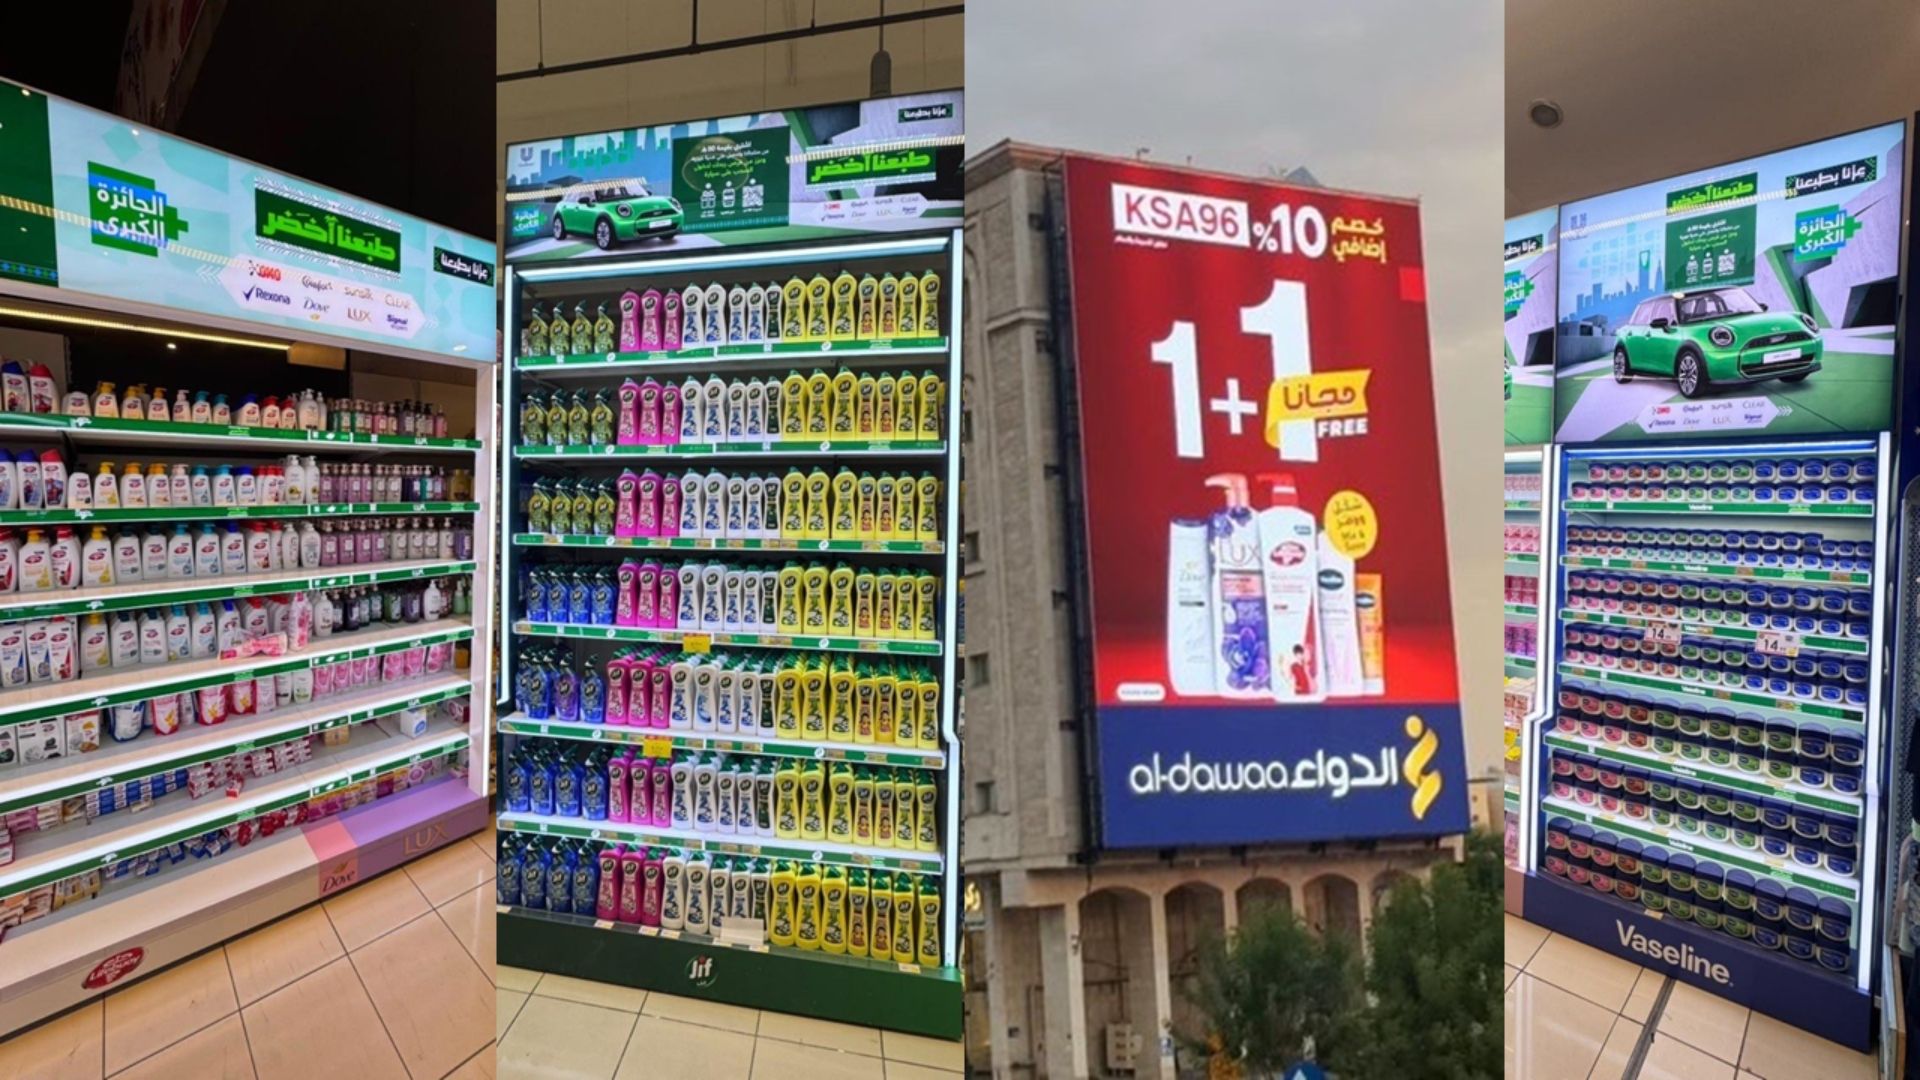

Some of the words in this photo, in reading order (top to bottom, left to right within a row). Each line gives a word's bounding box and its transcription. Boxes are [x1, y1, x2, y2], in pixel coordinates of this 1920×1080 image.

[97, 182, 164, 217] الجائزة
[1125, 193, 1239, 239] KSA96
[1331, 216, 1385, 236] خصم
[1799, 213, 1845, 236] الجائزة
[1333, 235, 1387, 264] إضافي
[1799, 229, 1845, 253] الكبرى
[255, 287, 291, 305] Rexona
[303, 299, 330, 314] Dove
[1317, 417, 1368, 438] FREE
[1651, 627, 1665, 640] 14
[1763, 638, 1779, 651] 14
[1129, 751, 1289, 793] al-dawaa
[1290, 746, 1399, 798] الدواء
[403, 823, 449, 855] LUX
[323, 871, 355, 892] Dove
[1616, 919, 1731, 984] Vaseline
